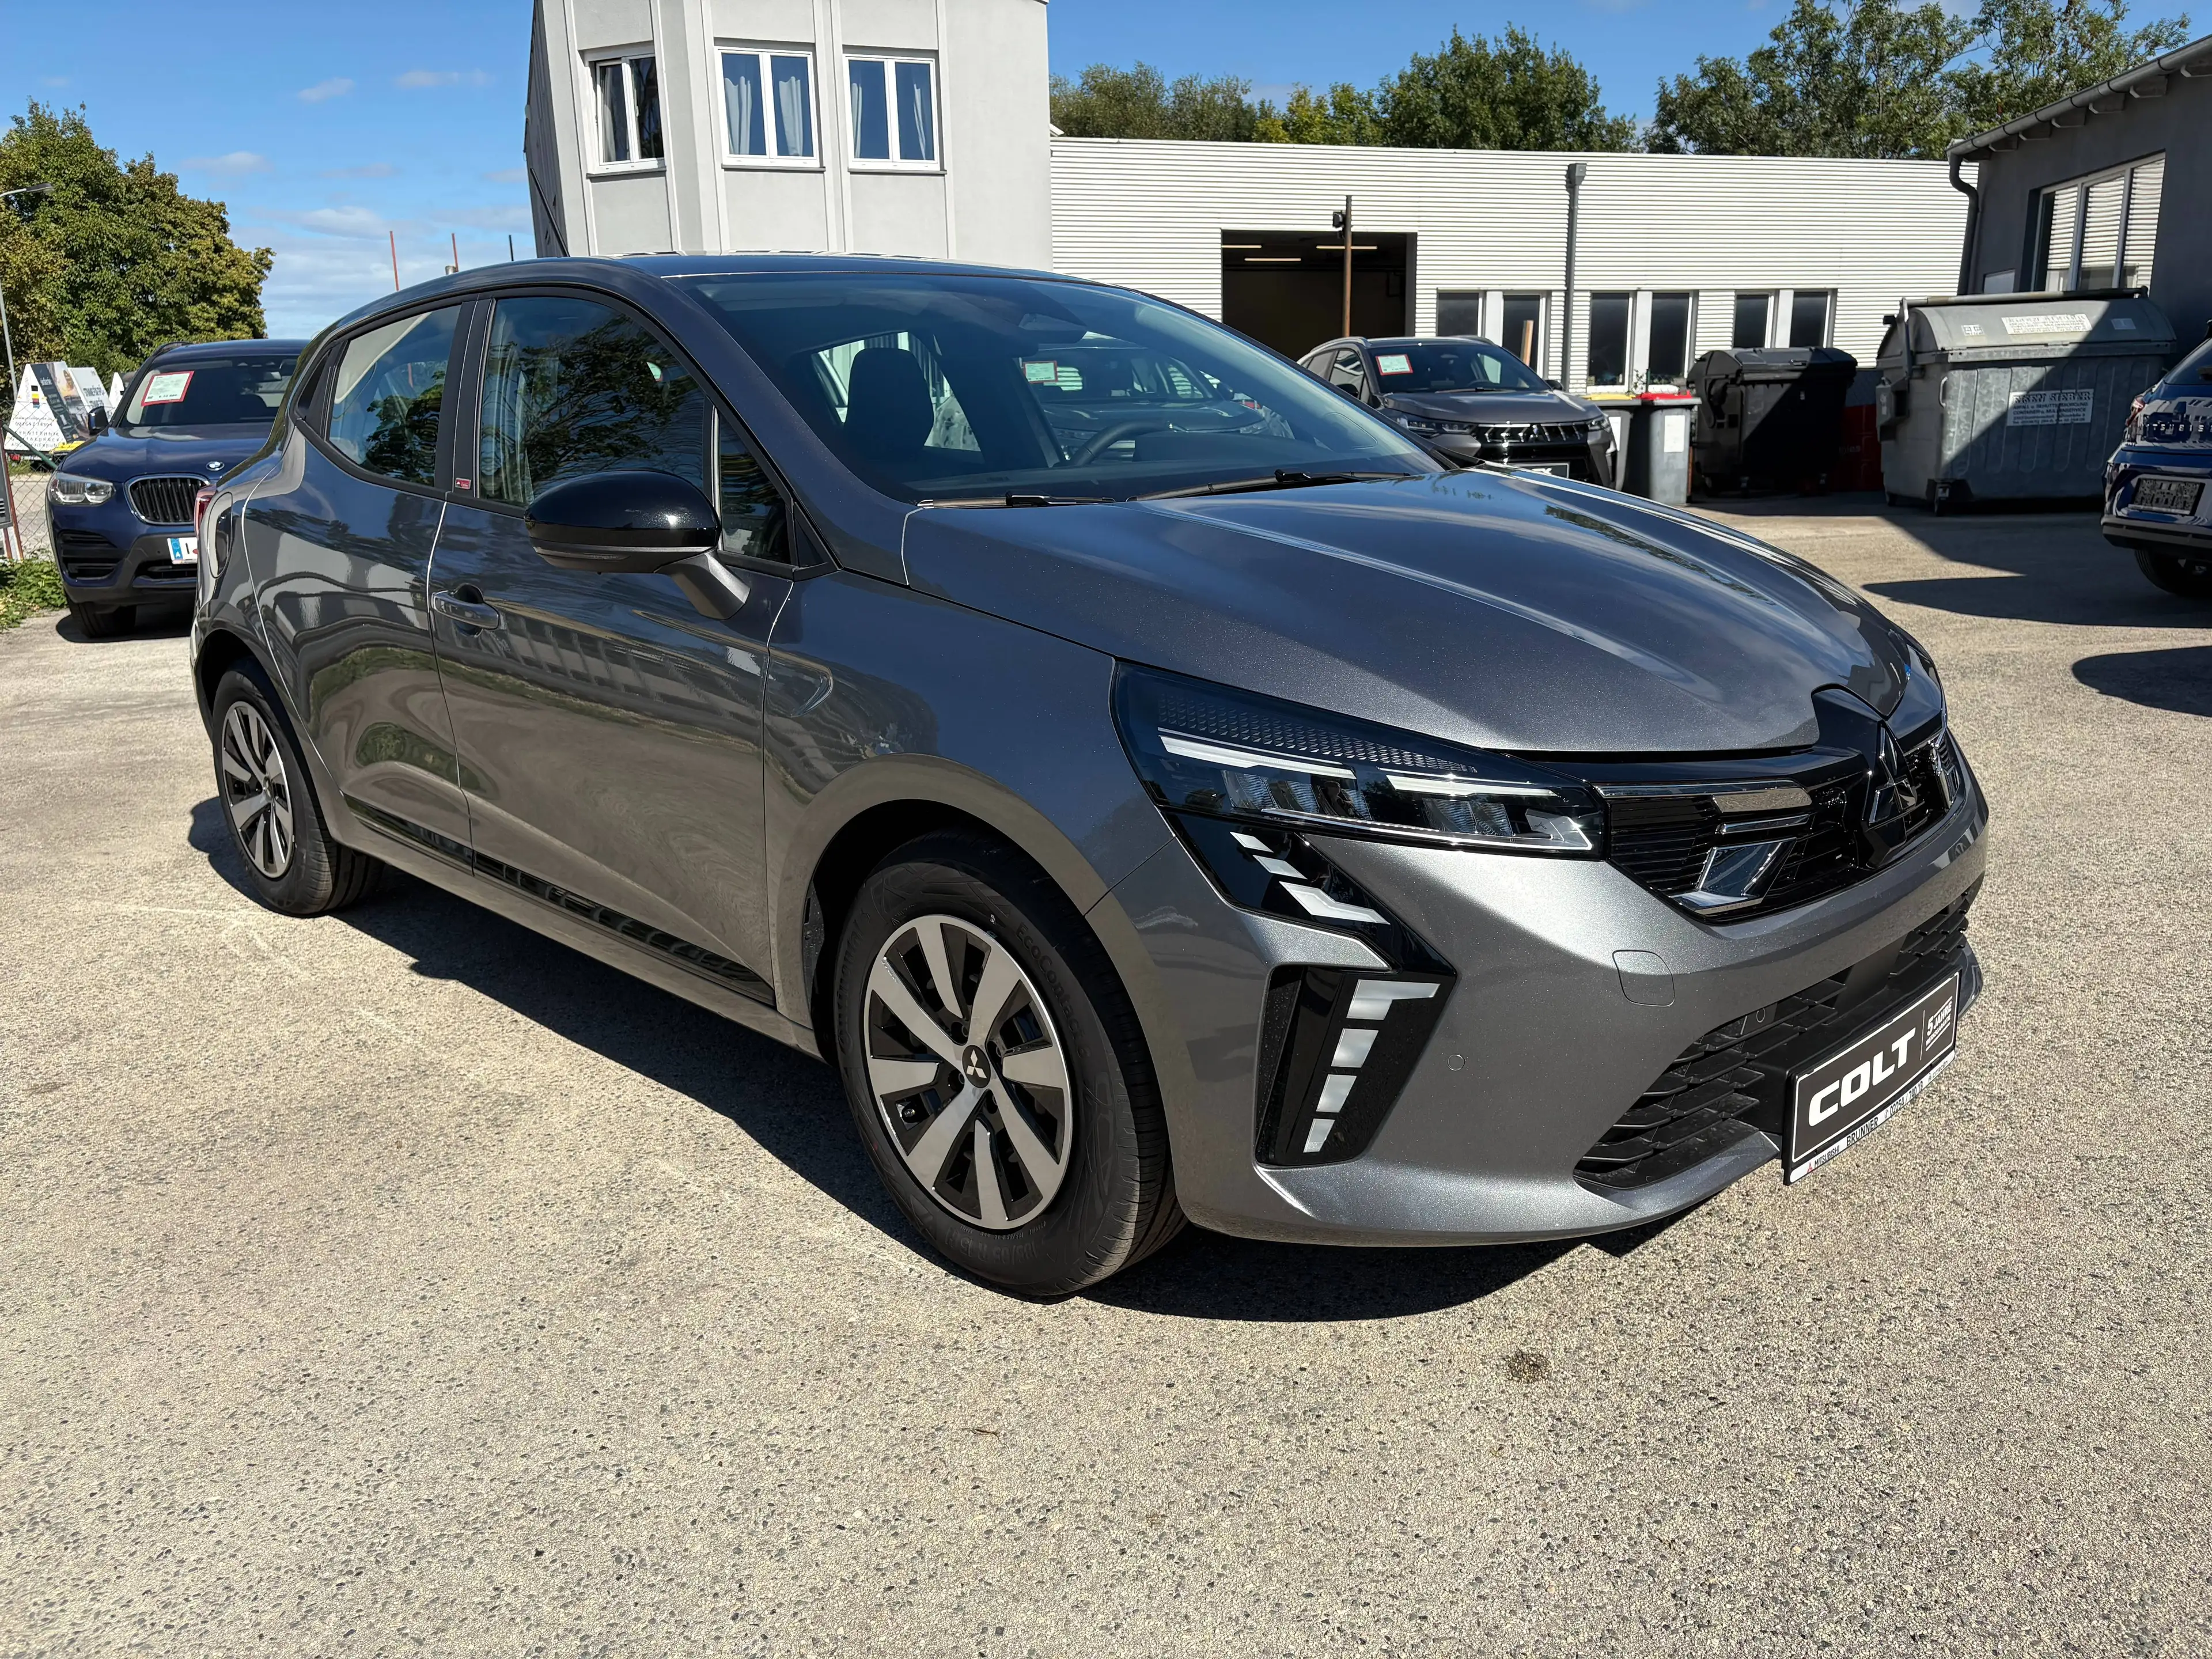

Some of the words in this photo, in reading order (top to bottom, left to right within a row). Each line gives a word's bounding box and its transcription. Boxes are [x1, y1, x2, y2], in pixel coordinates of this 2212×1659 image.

[1927, 1016, 1934, 1036] 5
[1933, 1000, 1952, 1029] JAHRE
[1809, 1027, 1916, 1127] COLT
[1814, 1145, 1840, 1168] MITSUBISHI
[1846, 1117, 1878, 1146] BRUNNER
